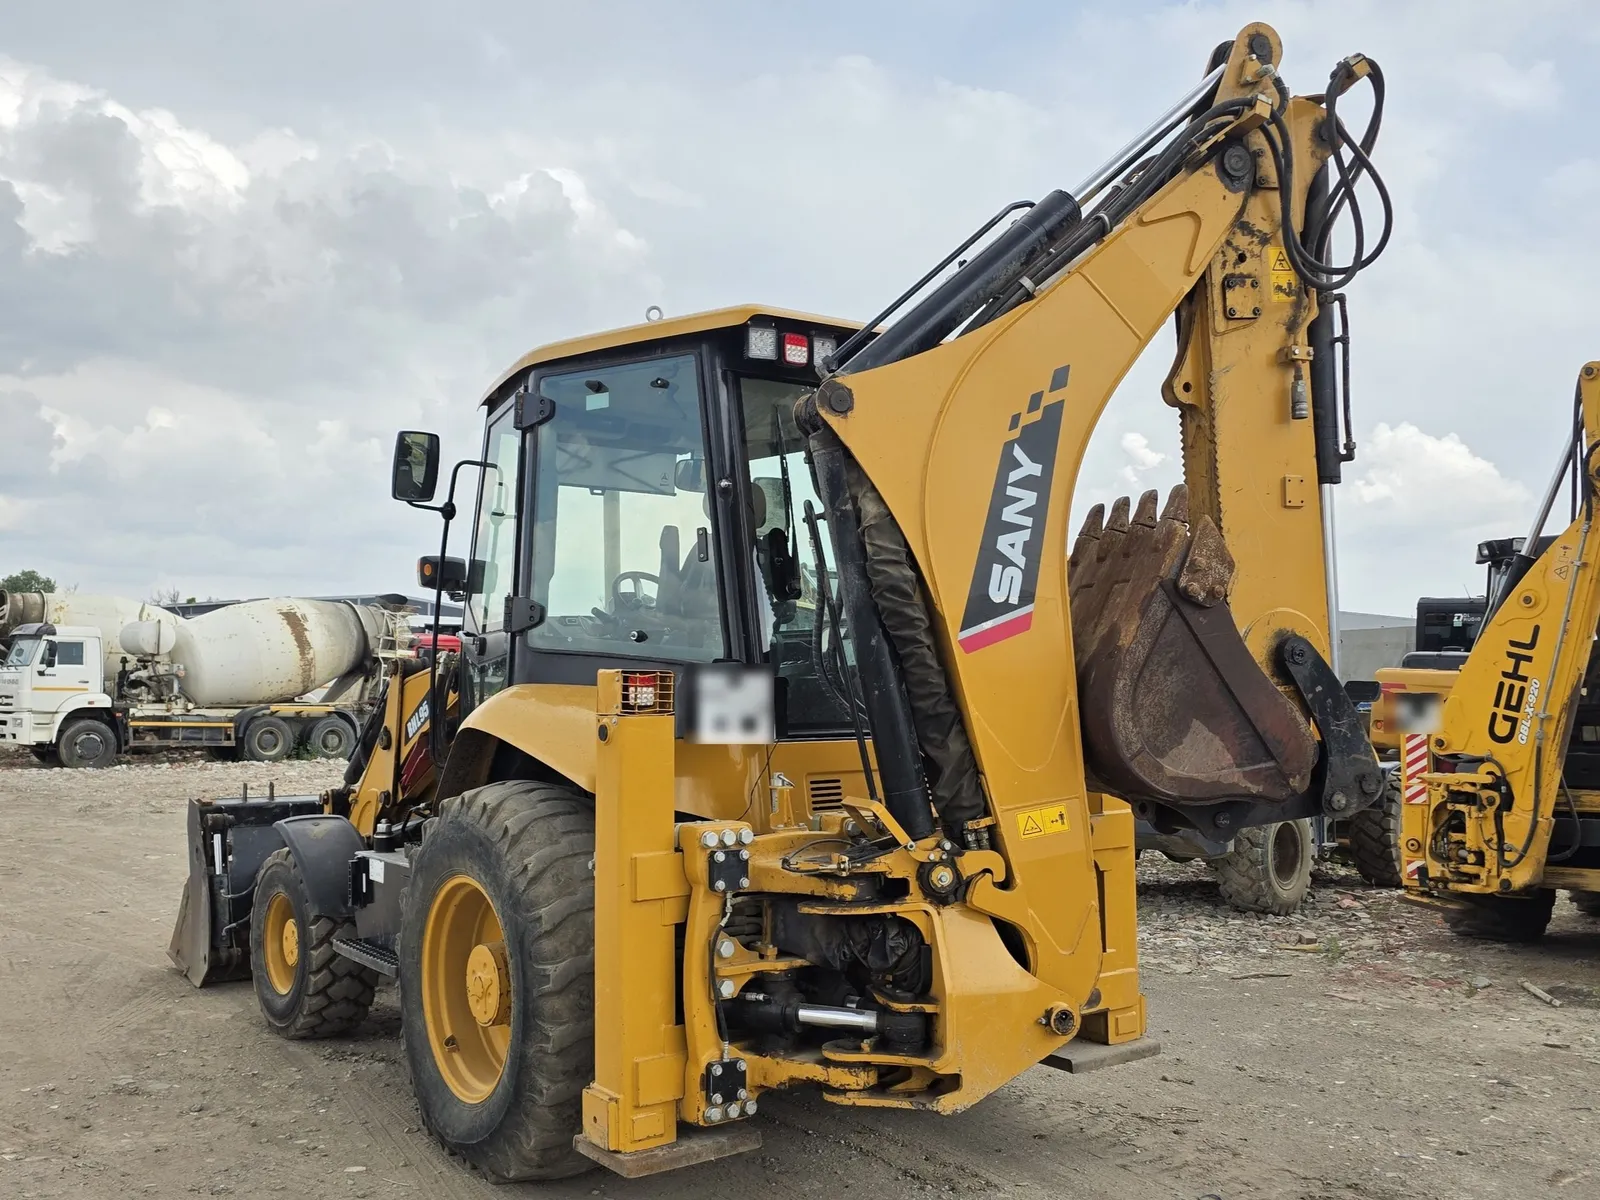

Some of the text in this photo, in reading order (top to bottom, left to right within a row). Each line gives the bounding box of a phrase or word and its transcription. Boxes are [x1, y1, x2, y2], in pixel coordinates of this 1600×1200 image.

[988, 443, 1043, 605] SANY
[406, 700, 430, 739] BHL95
[1488, 624, 1540, 744] GEHL
[1517, 678, 1540, 745] GBL-X-920
